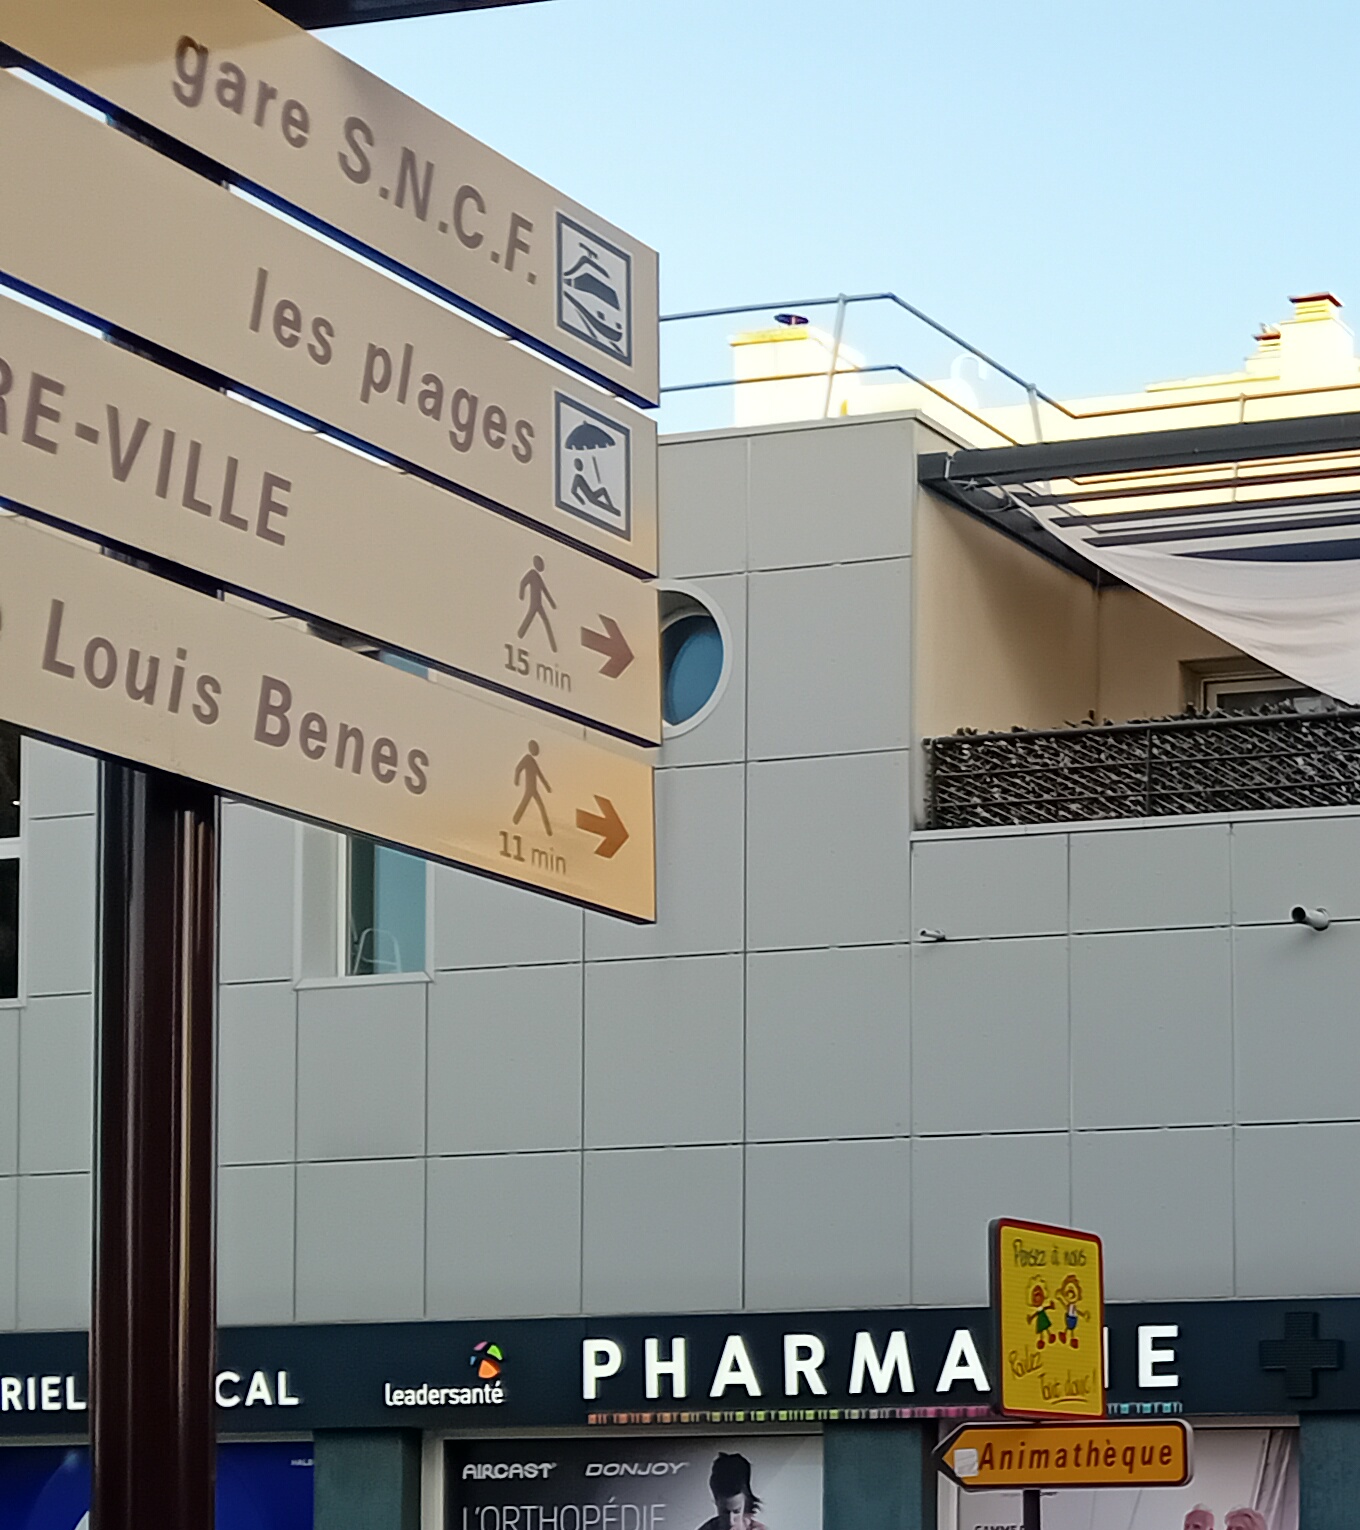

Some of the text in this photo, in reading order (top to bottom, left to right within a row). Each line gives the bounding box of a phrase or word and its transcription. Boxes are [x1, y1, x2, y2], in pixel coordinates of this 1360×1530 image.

[172, 35, 537, 285] gare S.N.C.F.
[248, 267, 534, 464] les plages
[504, 643, 571, 693] 15 min
[42, 598, 430, 795] Louis Benes
[499, 830, 566, 876] 11 min
[582, 1323, 1181, 1400] PHARMAE
[384, 1379, 504, 1406] leadersanté
[462, 1462, 685, 1480] AIRCAST DONJOY
[979, 1438, 1173, 1474] Animathèque
